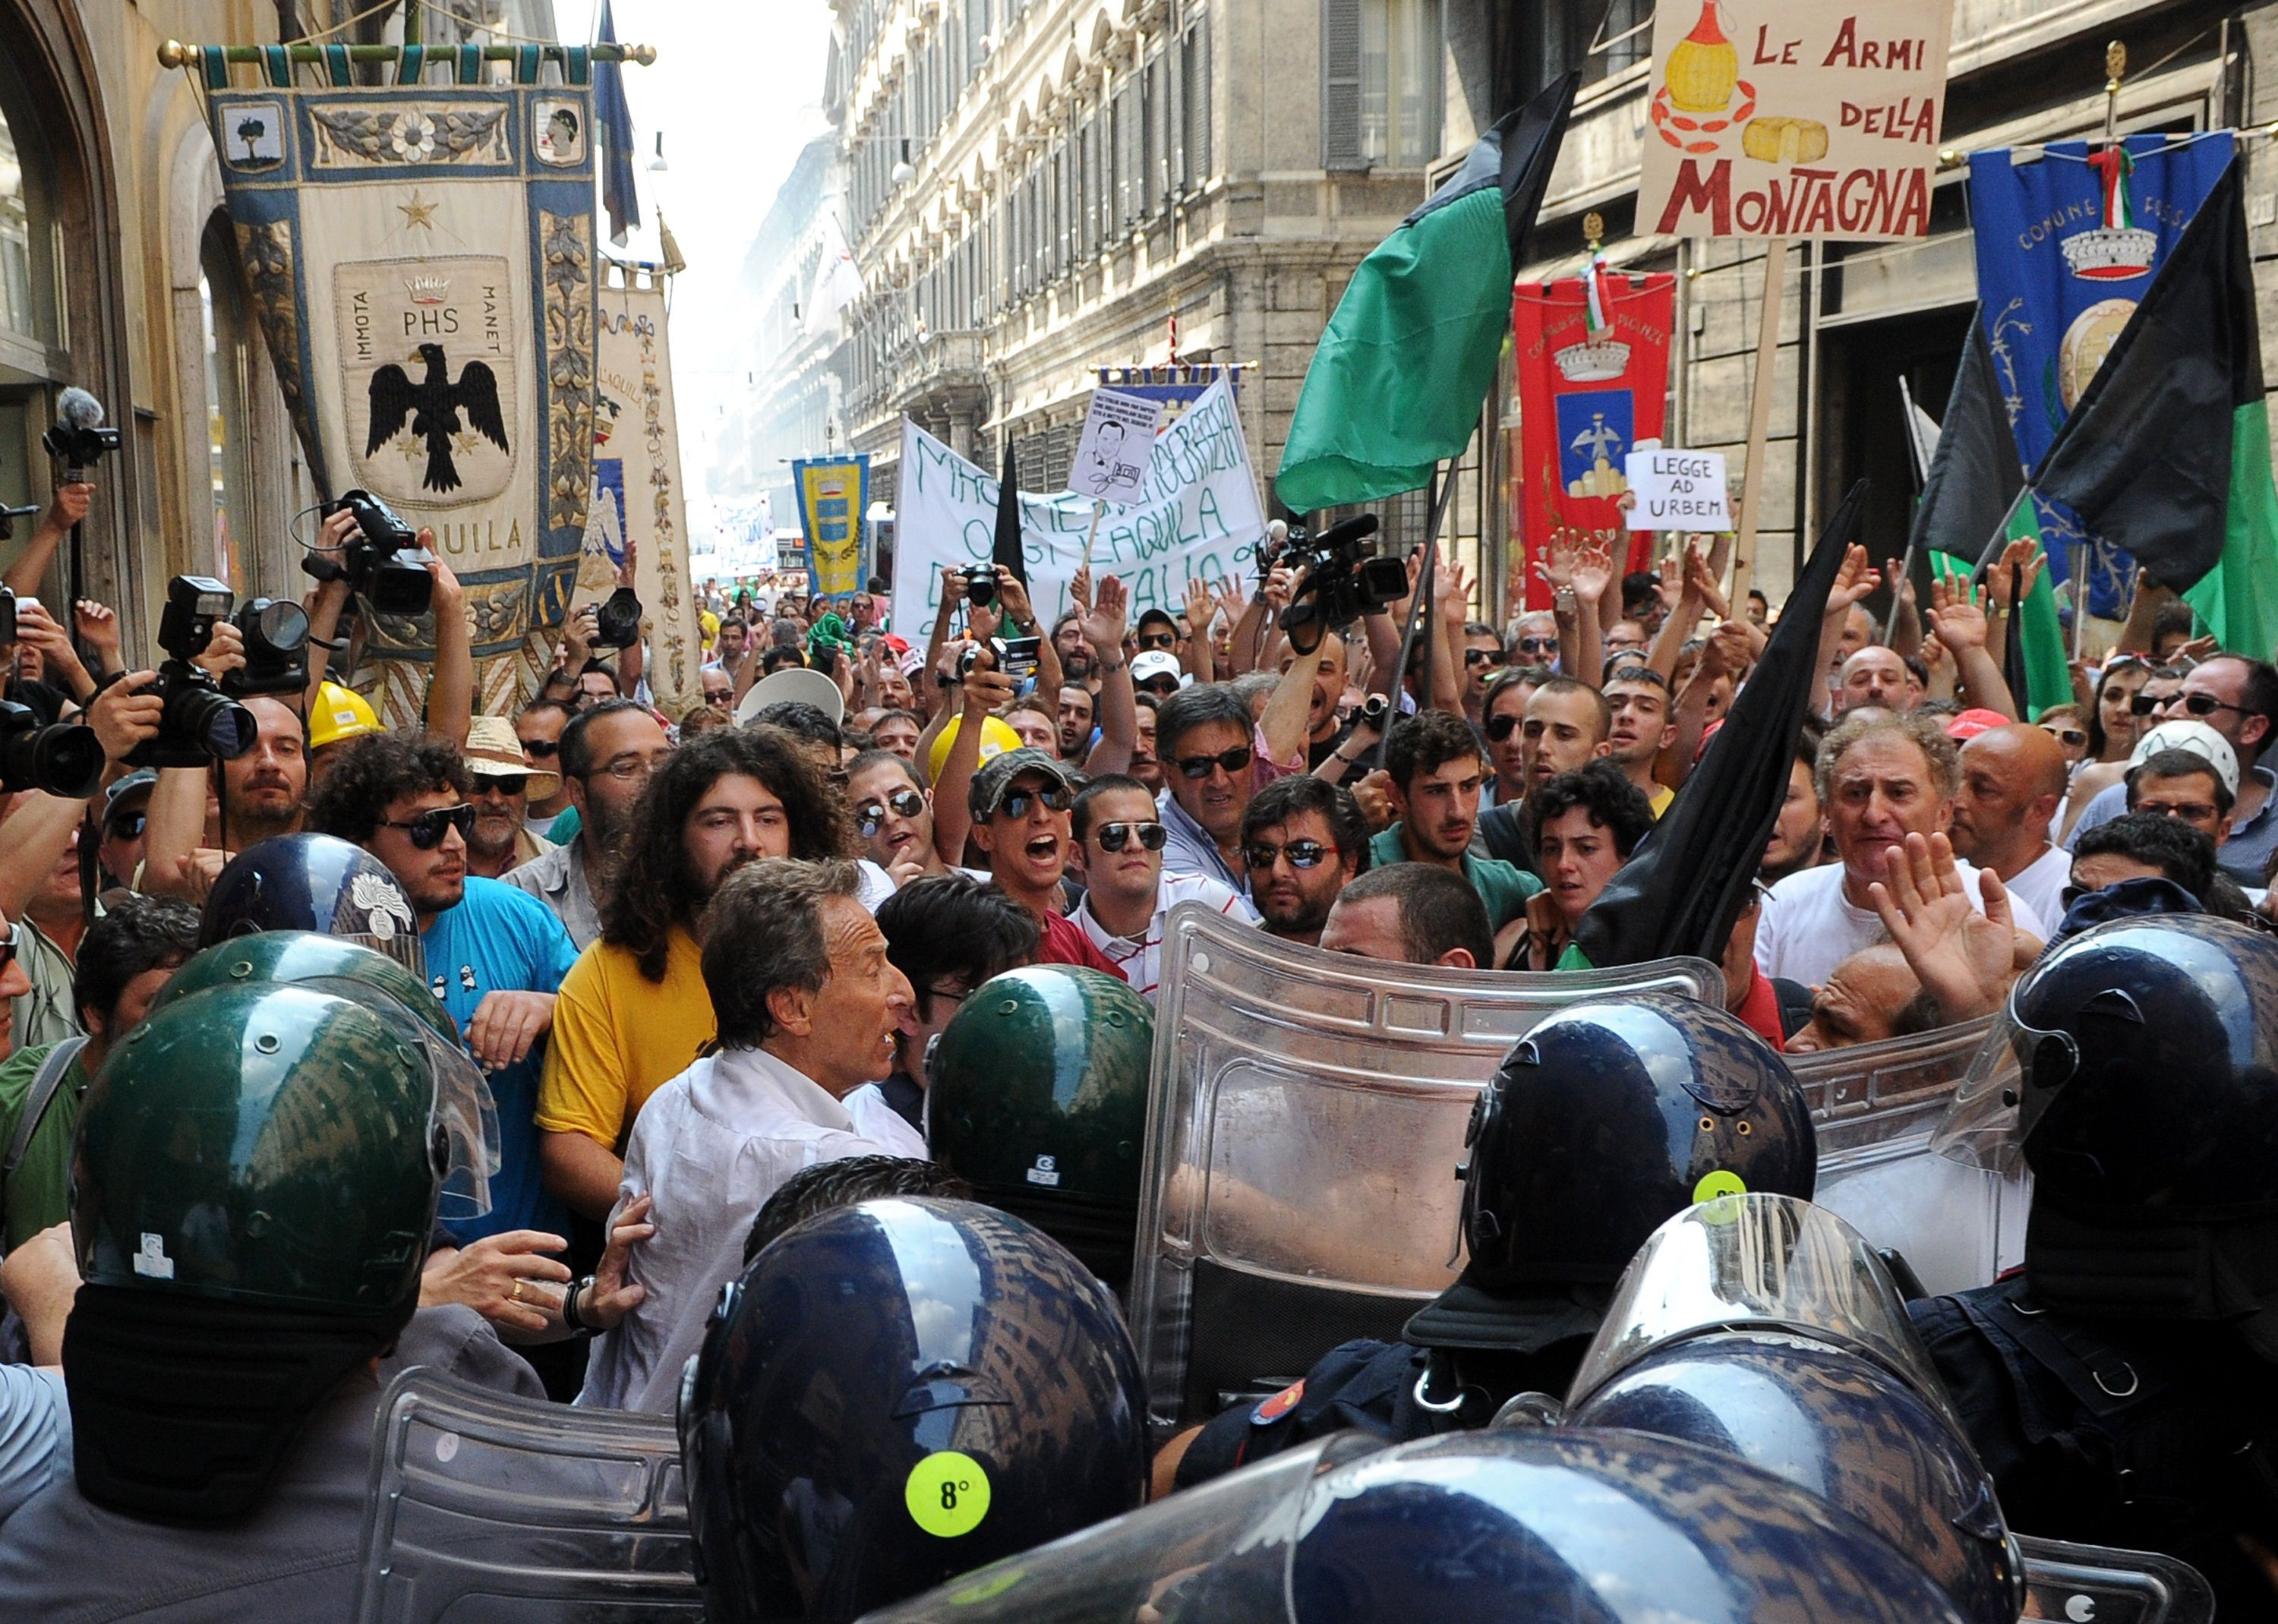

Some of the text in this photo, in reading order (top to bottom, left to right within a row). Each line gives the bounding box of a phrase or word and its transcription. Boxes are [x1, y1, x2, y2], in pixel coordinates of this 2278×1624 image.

[1840, 96, 1934, 145] DELLA
[2018, 198, 2097, 251] COMUNE
[354, 292, 372, 361] IMMOTA
[404, 308, 459, 336] PHS
[482, 285, 500, 354] MANET
[1653, 456, 1712, 478] LEGGE
[1671, 480, 1693, 494] AD
[1650, 500, 1721, 517] URBEM
[940, 1480, 970, 1510] 8°
